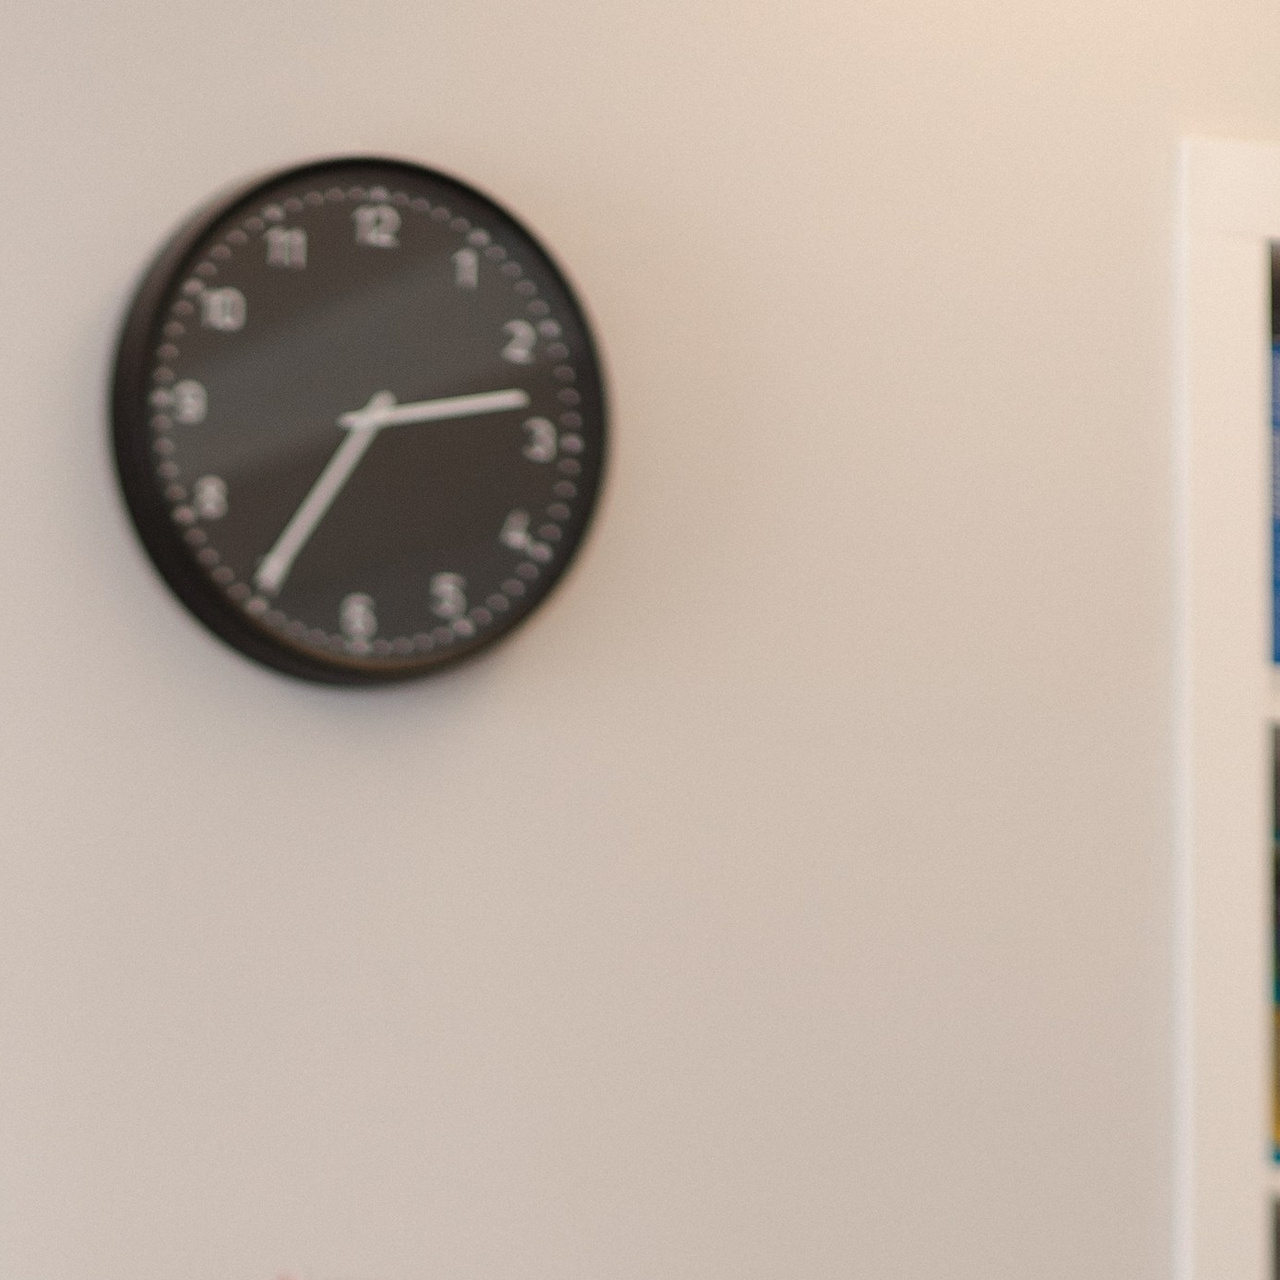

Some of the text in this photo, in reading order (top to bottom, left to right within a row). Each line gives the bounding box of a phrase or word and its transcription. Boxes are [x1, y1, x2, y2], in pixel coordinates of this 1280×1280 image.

[266, 227, 306, 265] 11
[354, 203, 400, 247] 12
[455, 249, 478, 286] 1
[199, 284, 245, 330] 10
[498, 318, 538, 366] 2
[521, 415, 558, 464] 3
